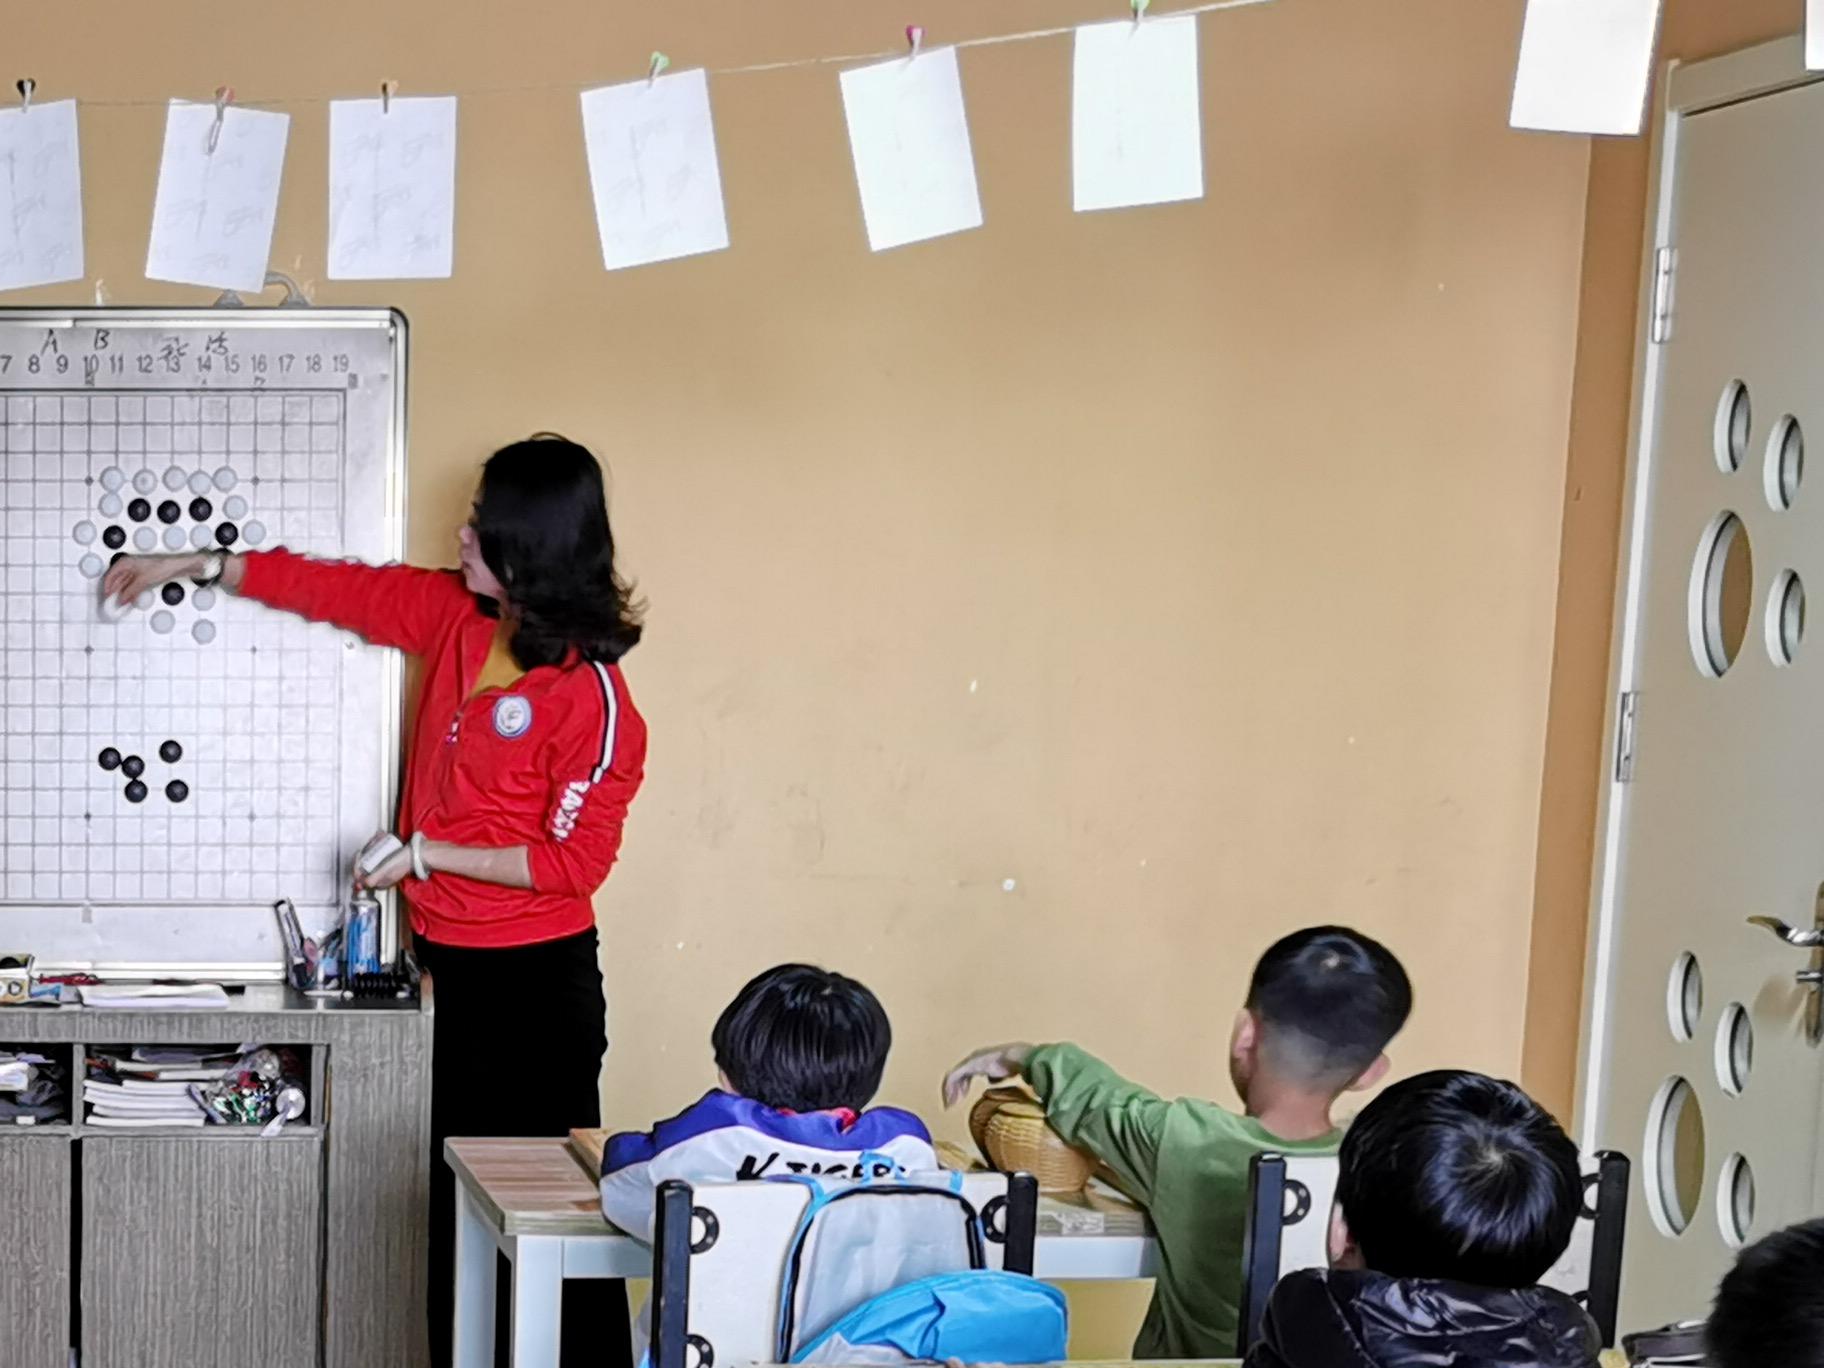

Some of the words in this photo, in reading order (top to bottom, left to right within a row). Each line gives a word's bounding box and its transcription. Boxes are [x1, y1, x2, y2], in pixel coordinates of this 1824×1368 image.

[41, 328, 58, 356] A
[94, 328, 111, 350] B
[27, 354, 41, 374] 8
[56, 354, 69, 374] 9
[83, 353, 100, 373] 10
[109, 354, 124, 374] 11
[135, 354, 154, 374] 12
[165, 354, 182, 373] 13
[196, 353, 213, 373] 14
[225, 353, 241, 374] 15
[250, 353, 268, 373] 16
[278, 353, 296, 373] 17
[305, 353, 322, 373] 18
[332, 353, 350, 373] 19
